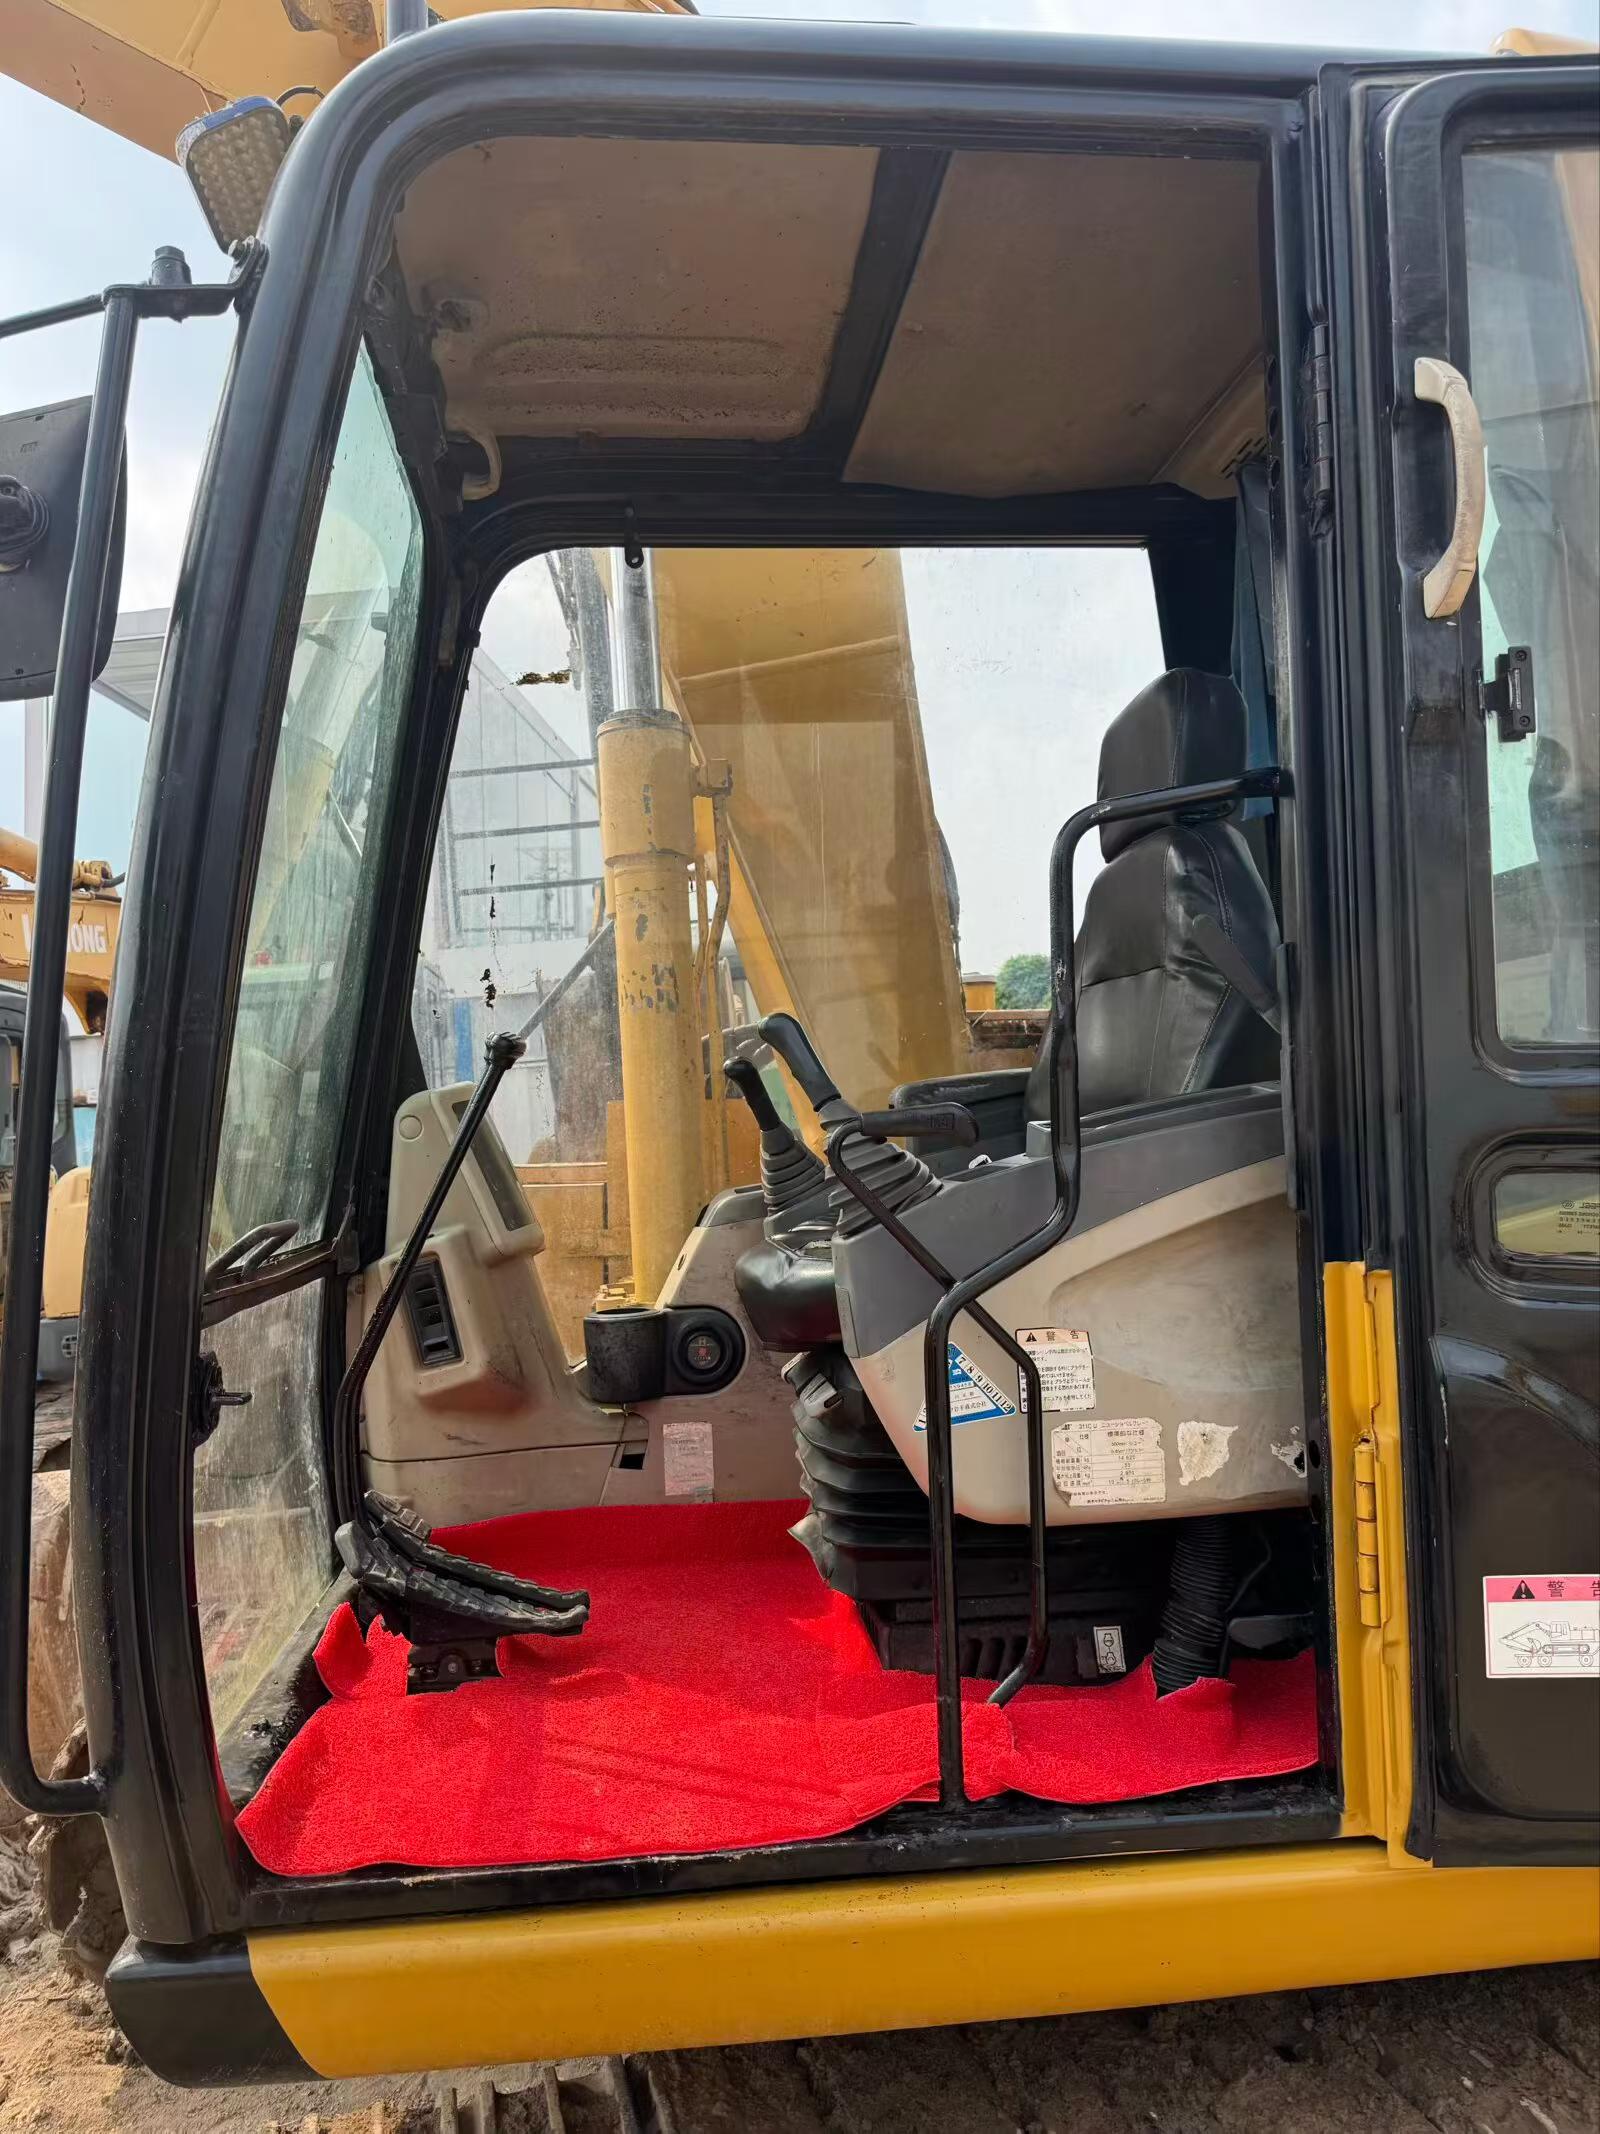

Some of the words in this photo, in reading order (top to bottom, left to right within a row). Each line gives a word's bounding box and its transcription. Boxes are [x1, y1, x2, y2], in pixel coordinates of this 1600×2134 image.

[958, 1356, 966, 1364] 7
[967, 1365, 975, 1374] 8
[975, 1375, 983, 1383] 9
[983, 1383, 994, 1392] 10
[992, 1392, 1003, 1401] 11
[1000, 1400, 1012, 1412] 12
